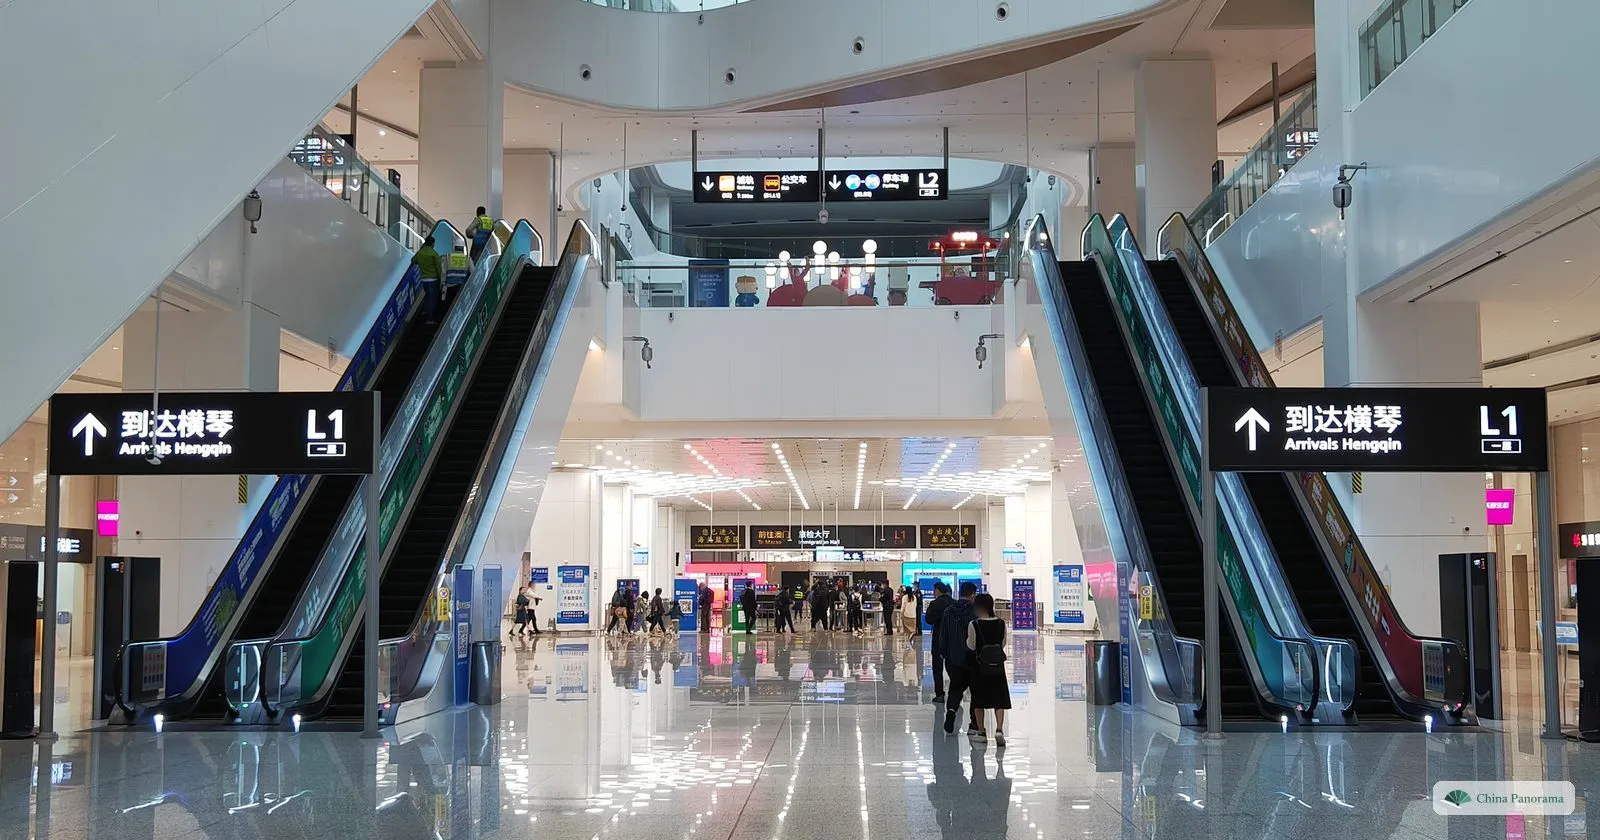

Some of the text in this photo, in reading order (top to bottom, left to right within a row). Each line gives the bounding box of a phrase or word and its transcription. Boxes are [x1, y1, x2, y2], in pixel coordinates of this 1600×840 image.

[781, 175, 807, 184] 公交车
[919, 172, 939, 188] L2
[120, 409, 234, 438] 到达横琴
[307, 409, 343, 440] L1
[1284, 405, 1402, 434] 到达横琴
[1480, 405, 1518, 436] L1
[174, 442, 232, 458] Hengqin
[1284, 438, 1402, 454] Arrivals Hengqin
[758, 530, 790, 538] 前往澳门
[894, 530, 906, 540] L1
